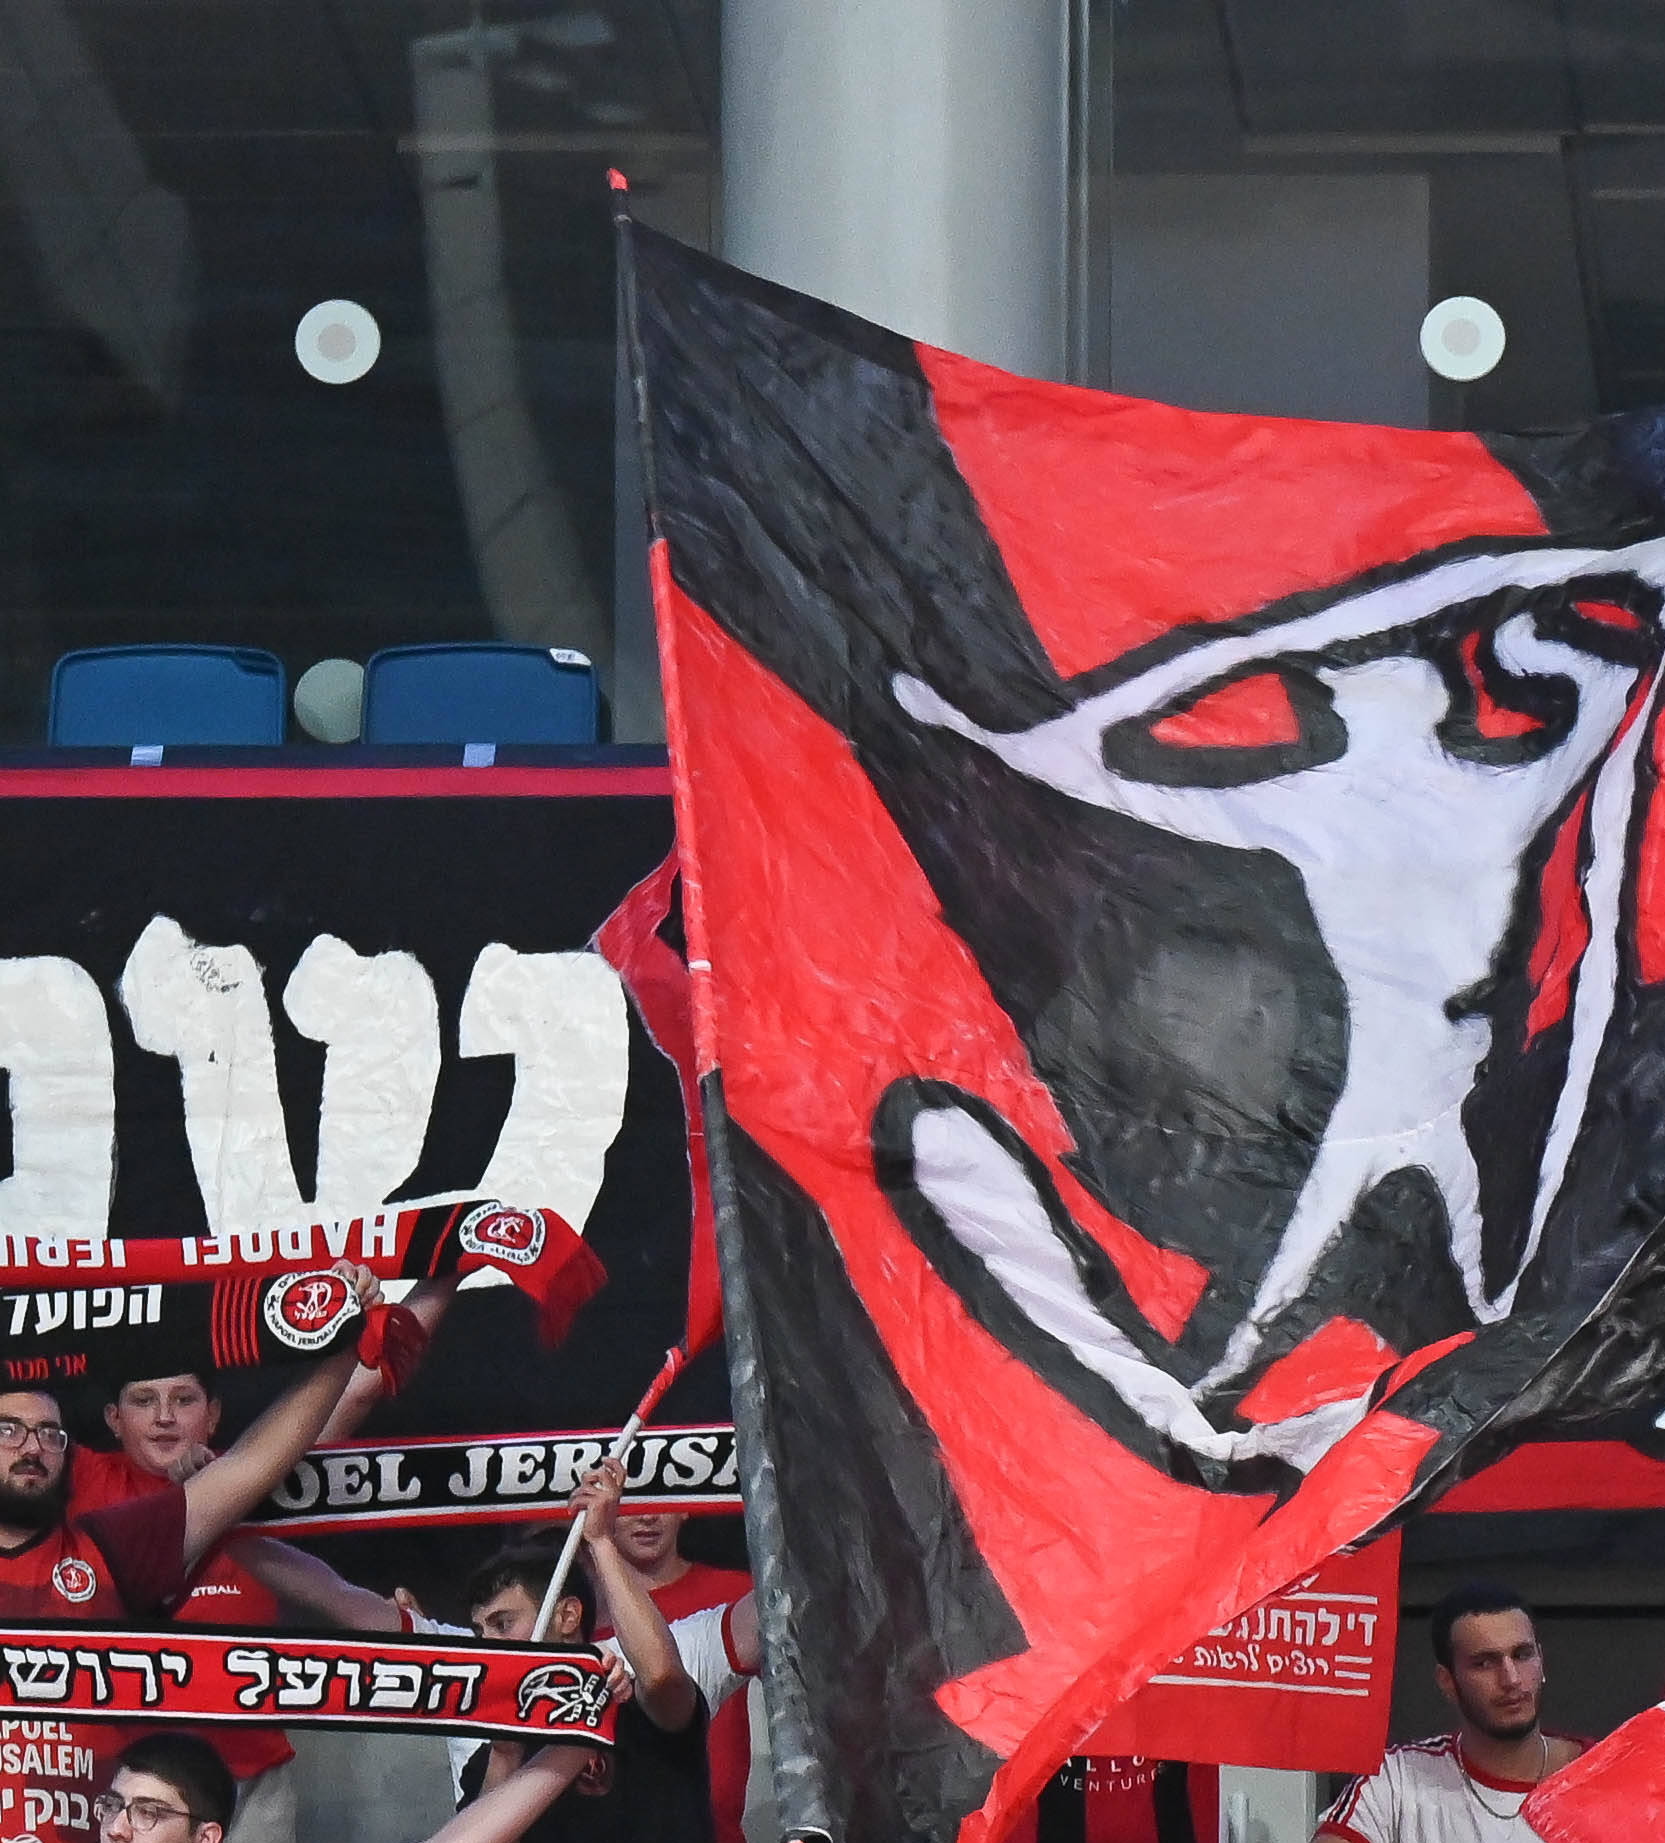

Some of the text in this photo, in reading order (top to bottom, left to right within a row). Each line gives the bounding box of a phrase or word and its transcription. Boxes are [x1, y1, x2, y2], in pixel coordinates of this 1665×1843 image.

[4, 1283, 163, 1335] הפועל
[53, 1352, 88, 1377] אני
[2, 1646, 488, 1712] הפועל ירוש
[0, 1743, 94, 1780] SALEM
